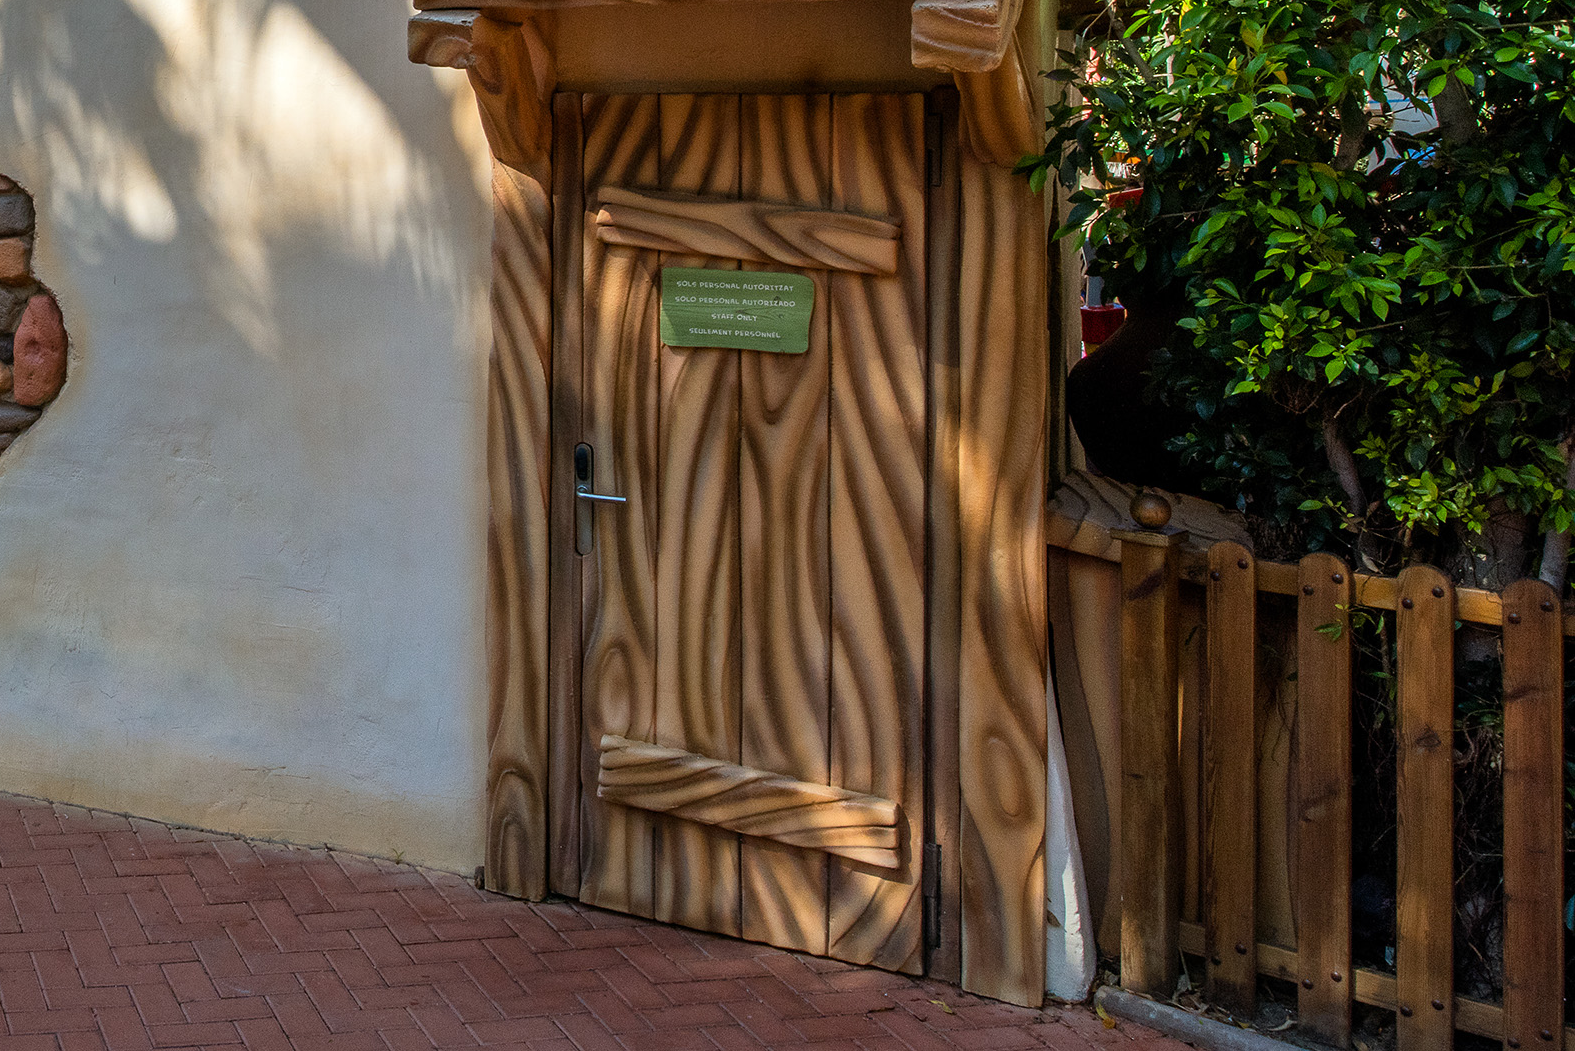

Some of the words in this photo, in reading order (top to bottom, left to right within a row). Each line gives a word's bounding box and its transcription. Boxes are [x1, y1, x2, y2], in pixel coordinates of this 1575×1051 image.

[699, 281, 740, 289] PERSONAL
[742, 283, 794, 291] AUTORITZAT
[675, 295, 696, 303] SOLO
[698, 297, 740, 305] PERSONAL
[742, 298, 796, 307] AUTORIZADO
[736, 313, 758, 321] ONLY
[689, 327, 732, 336] SEULEMENT
[734, 329, 781, 338] PERSONNEL
